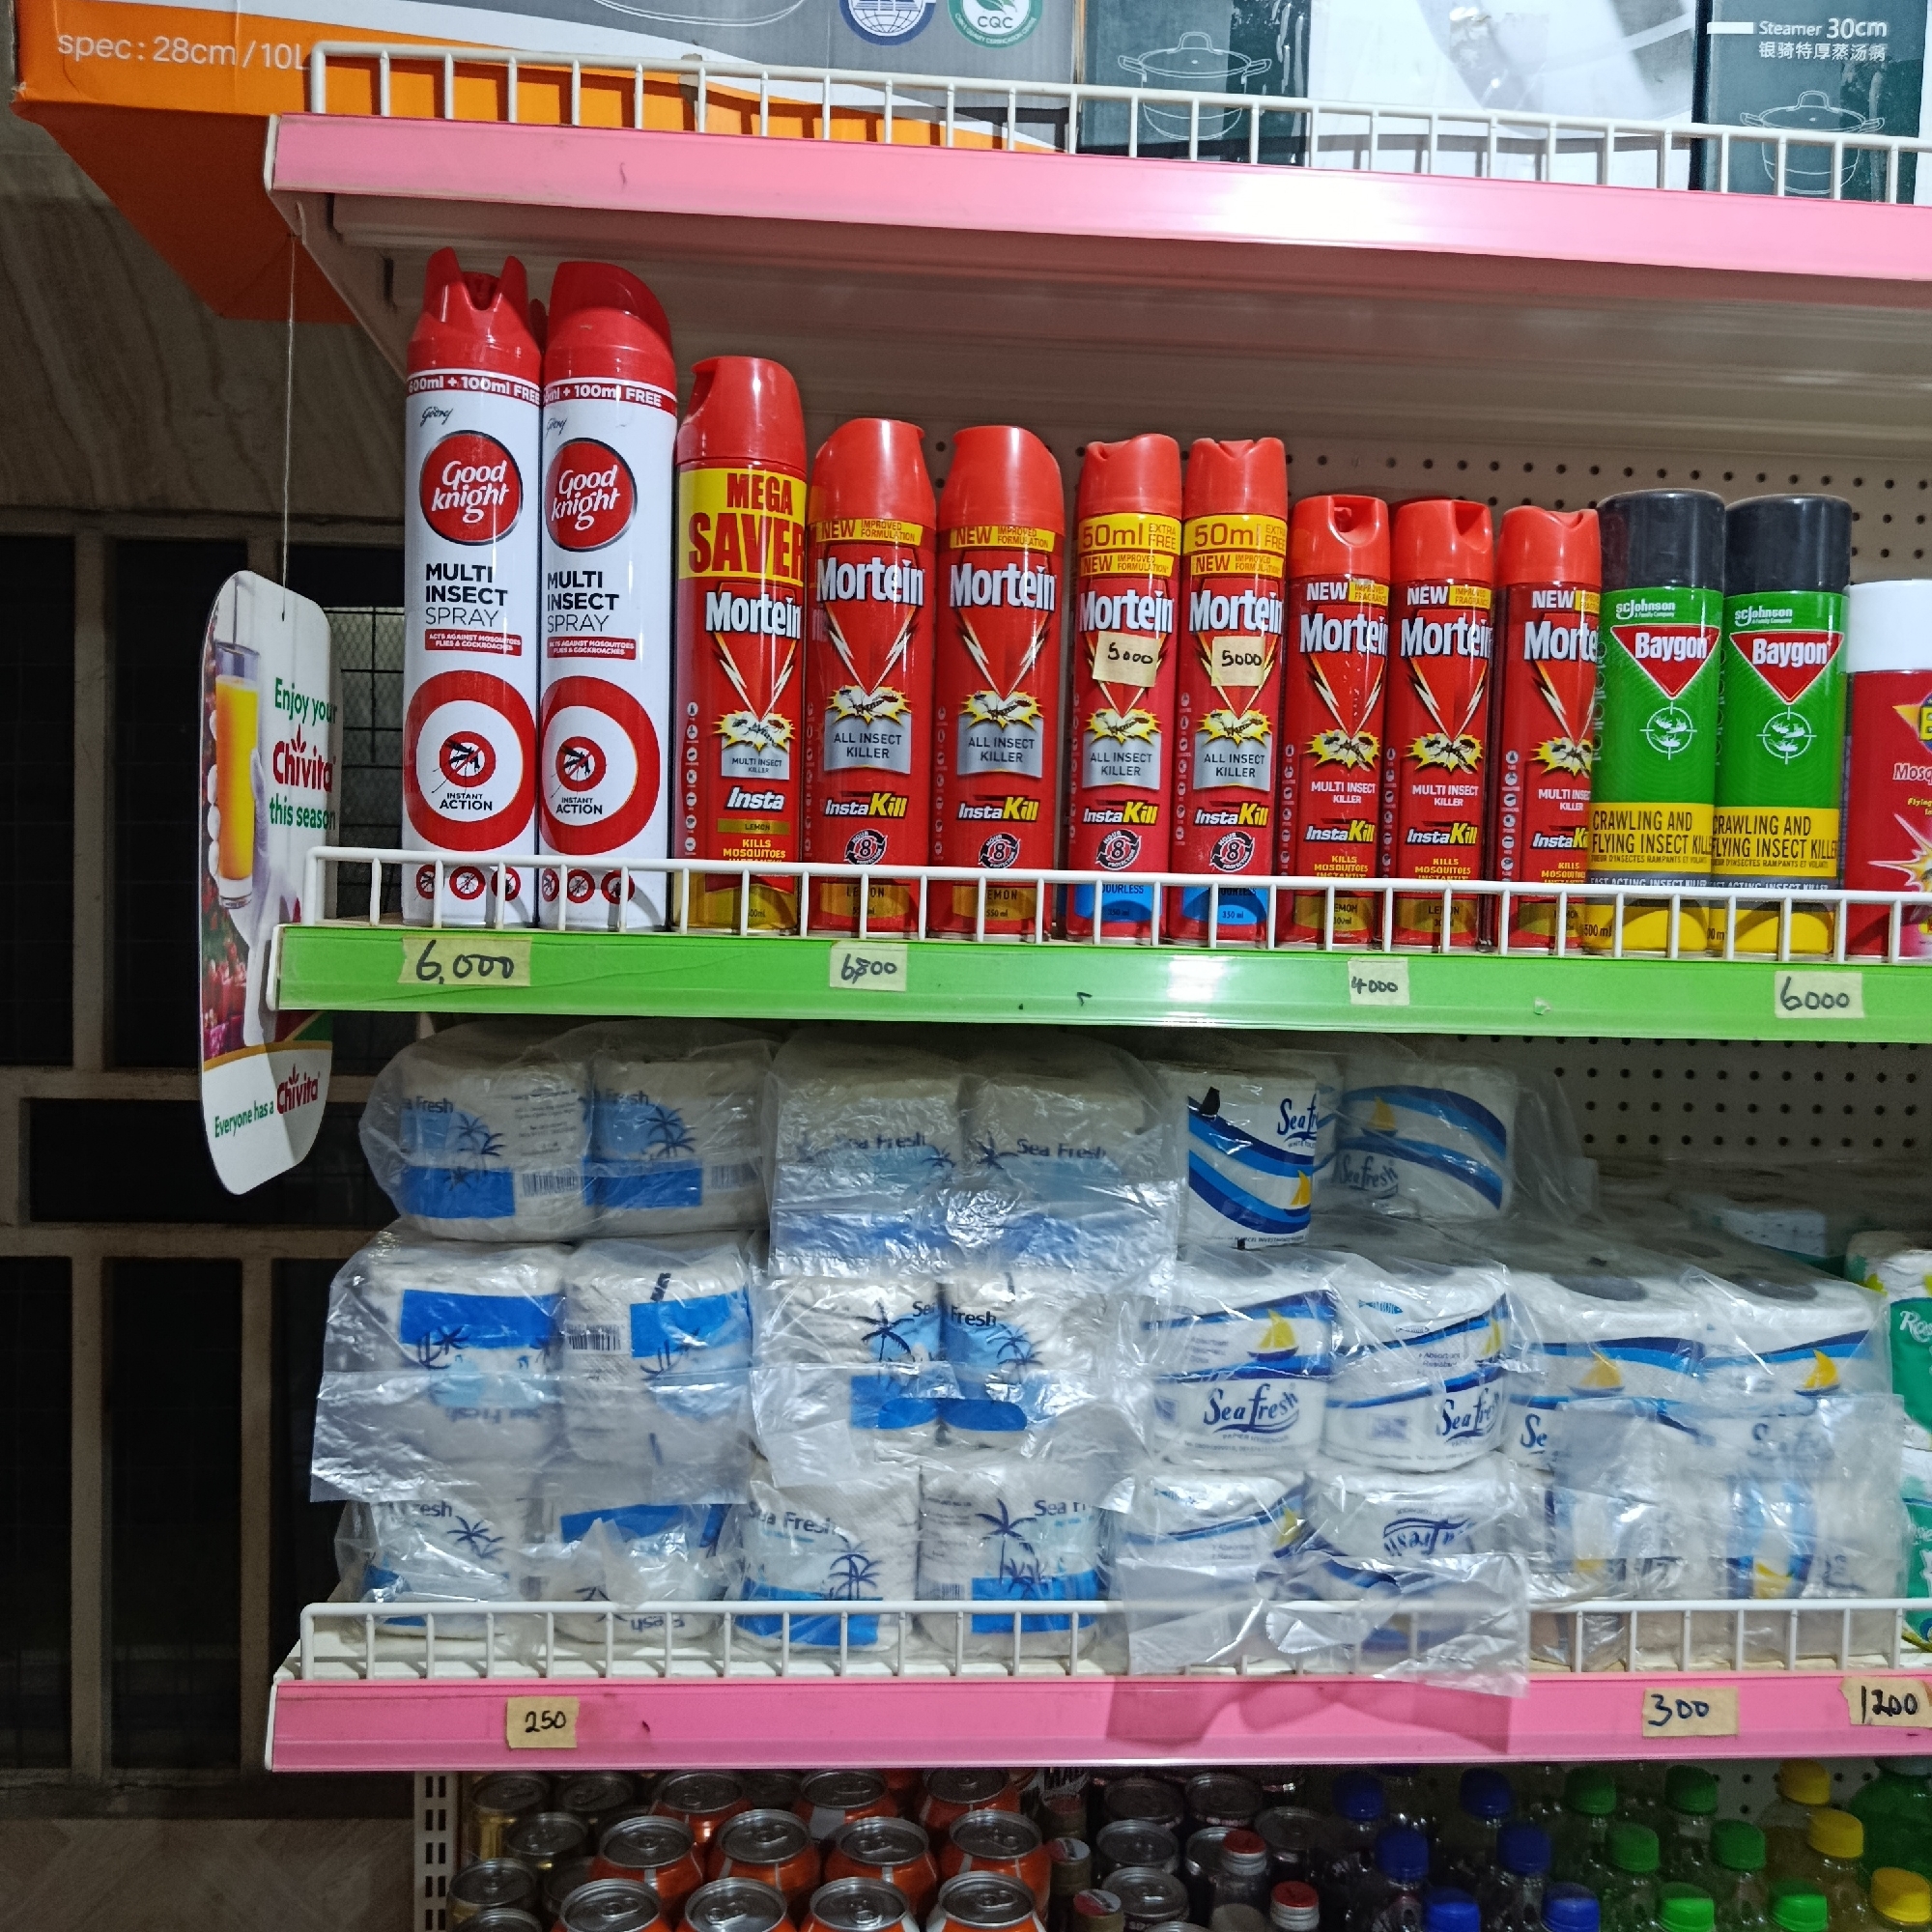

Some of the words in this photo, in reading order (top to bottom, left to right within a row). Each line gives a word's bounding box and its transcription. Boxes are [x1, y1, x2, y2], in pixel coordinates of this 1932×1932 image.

[978, 15, 1013, 28] CQC
[1758, 19, 1823, 37] Steamer
[1826, 17, 1888, 39] 30cm
[461, 377, 510, 394] 100ml
[625, 386, 664, 408] FREE
[441, 460, 508, 488] Good
[558, 464, 618, 496] Good
[431, 482, 510, 525] knight
[727, 472, 793, 515] MEGA
[551, 488, 620, 531] knight
[822, 520, 856, 539] NEW
[955, 526, 992, 545] NEW
[1082, 523, 1144, 549] 50ml
[1148, 524, 1177, 537] EXTRA
[1194, 523, 1261, 548] 50ml
[1148, 533, 1177, 551] FREE
[425, 563, 494, 583] MULTI
[1083, 554, 1112, 573] NEW
[1196, 554, 1230, 572] NEW
[547, 571, 603, 588] MULTI
[816, 556, 924, 607] Mortein
[950, 562, 1057, 611] Mortein
[425, 585, 508, 607] INSECT
[1306, 582, 1348, 601] NEW
[1406, 585, 1448, 606] NEW
[1531, 590, 1575, 609] NEW
[547, 593, 620, 611] INSECT
[1079, 589, 1174, 634] Mortein
[1189, 589, 1283, 635] Mortein
[425, 607, 499, 629] SPRAY
[547, 613, 611, 634] SPRAY
[705, 591, 802, 639] Mortein
[1299, 612, 1389, 656] Mortein
[1107, 642, 1153, 665] 5000
[1634, 632, 1708, 663] Baygon
[1752, 638, 1828, 668] Baygon
[1221, 649, 1263, 668] 5000
[274, 676, 309, 724] Enjoy
[311, 697, 338, 726] your
[834, 733, 856, 744] ALL
[859, 733, 902, 746] INSECT
[968, 736, 990, 748] ALL
[993, 736, 1036, 750] INSECT
[731, 757, 756, 766] MULTI
[757, 758, 782, 768] INSECT
[846, 747, 891, 759] KILLER
[980, 752, 1024, 763] KILLER
[1090, 753, 1110, 763] ALL
[1113, 753, 1152, 763] INSECT
[1204, 753, 1226, 763] ALL
[1229, 753, 1265, 765] INSECT
[272, 736, 334, 794] Chivita
[1100, 766, 1141, 776] KILLER
[1215, 767, 1256, 778] KILLER
[446, 792, 483, 801] INSTANT
[1311, 781, 1345, 792] MULTI
[1347, 782, 1376, 793] INSECT
[1412, 784, 1446, 796] MULTI
[1448, 785, 1479, 796] INSECT
[1538, 788, 1571, 800] MULTI
[439, 799, 493, 811] ACTION
[726, 786, 784, 811] Insta
[1332, 794, 1362, 804] KILLER
[1434, 797, 1464, 807] KILLER
[1559, 803, 1583, 811] KILLER
[270, 792, 293, 828] this
[296, 806, 336, 831] season
[555, 804, 603, 815] ACTION
[1592, 810, 1662, 831] CRAWLING
[1667, 811, 1692, 832] AND
[1713, 814, 1778, 836] CRAWLING
[1783, 815, 1811, 836] AND
[742, 838, 771, 848] KILLS
[1591, 833, 1634, 854] FLYING
[1640, 834, 1689, 854] INSECT
[1756, 838, 1806, 859] INSECT
[723, 848, 786, 859] MOSQUITOES
[1331, 855, 1357, 864] KILLS
[1314, 864, 1369, 872] MOSQUITOES
[1350, 977, 1399, 994] 4000
[1780, 976, 1850, 1010] 6000
[214, 1109, 252, 1139] Everyone
[254, 1099, 269, 1122] has
[269, 1100, 274, 1114] a
[276, 1072, 319, 1115] Chivita
[1015, 1138, 1050, 1156] Sea
[1057, 1142, 1107, 1159] Fresh
[951, 1305, 997, 1328] Fresh
[1034, 1499, 1067, 1517] Sea
[1647, 1693, 1710, 1727] 300
[1861, 1685, 1918, 1724] 1200
[525, 1710, 567, 1733] 250
